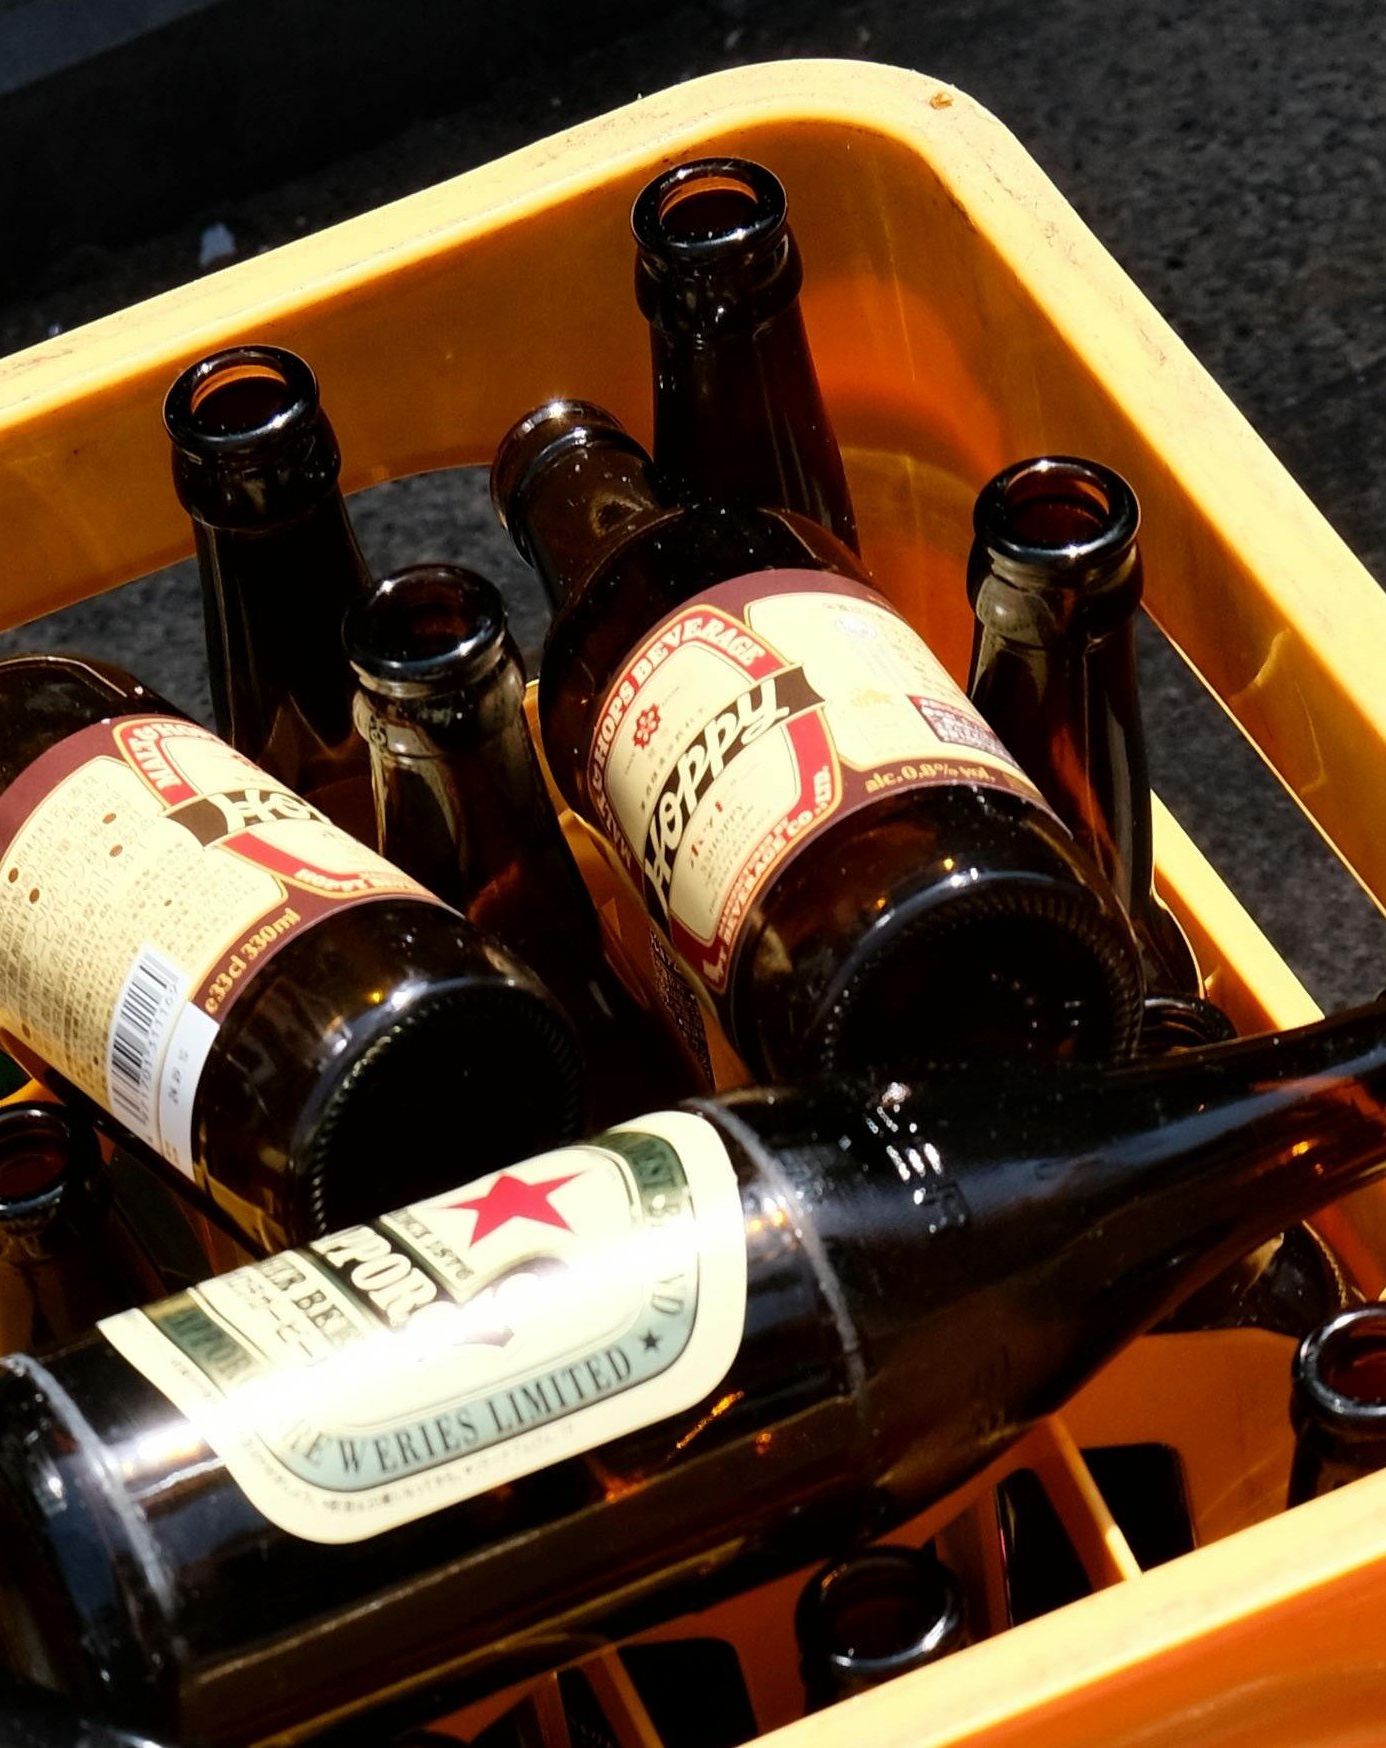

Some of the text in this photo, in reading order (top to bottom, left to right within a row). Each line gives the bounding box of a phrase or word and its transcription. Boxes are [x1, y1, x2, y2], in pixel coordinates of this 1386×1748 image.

[593, 678, 635, 761] HOPS
[631, 616, 767, 685] BEVERAGE
[129, 735, 183, 788] MALT
[239, 906, 302, 962] 330ml
[485, 1341, 634, 1434] LIMITED
